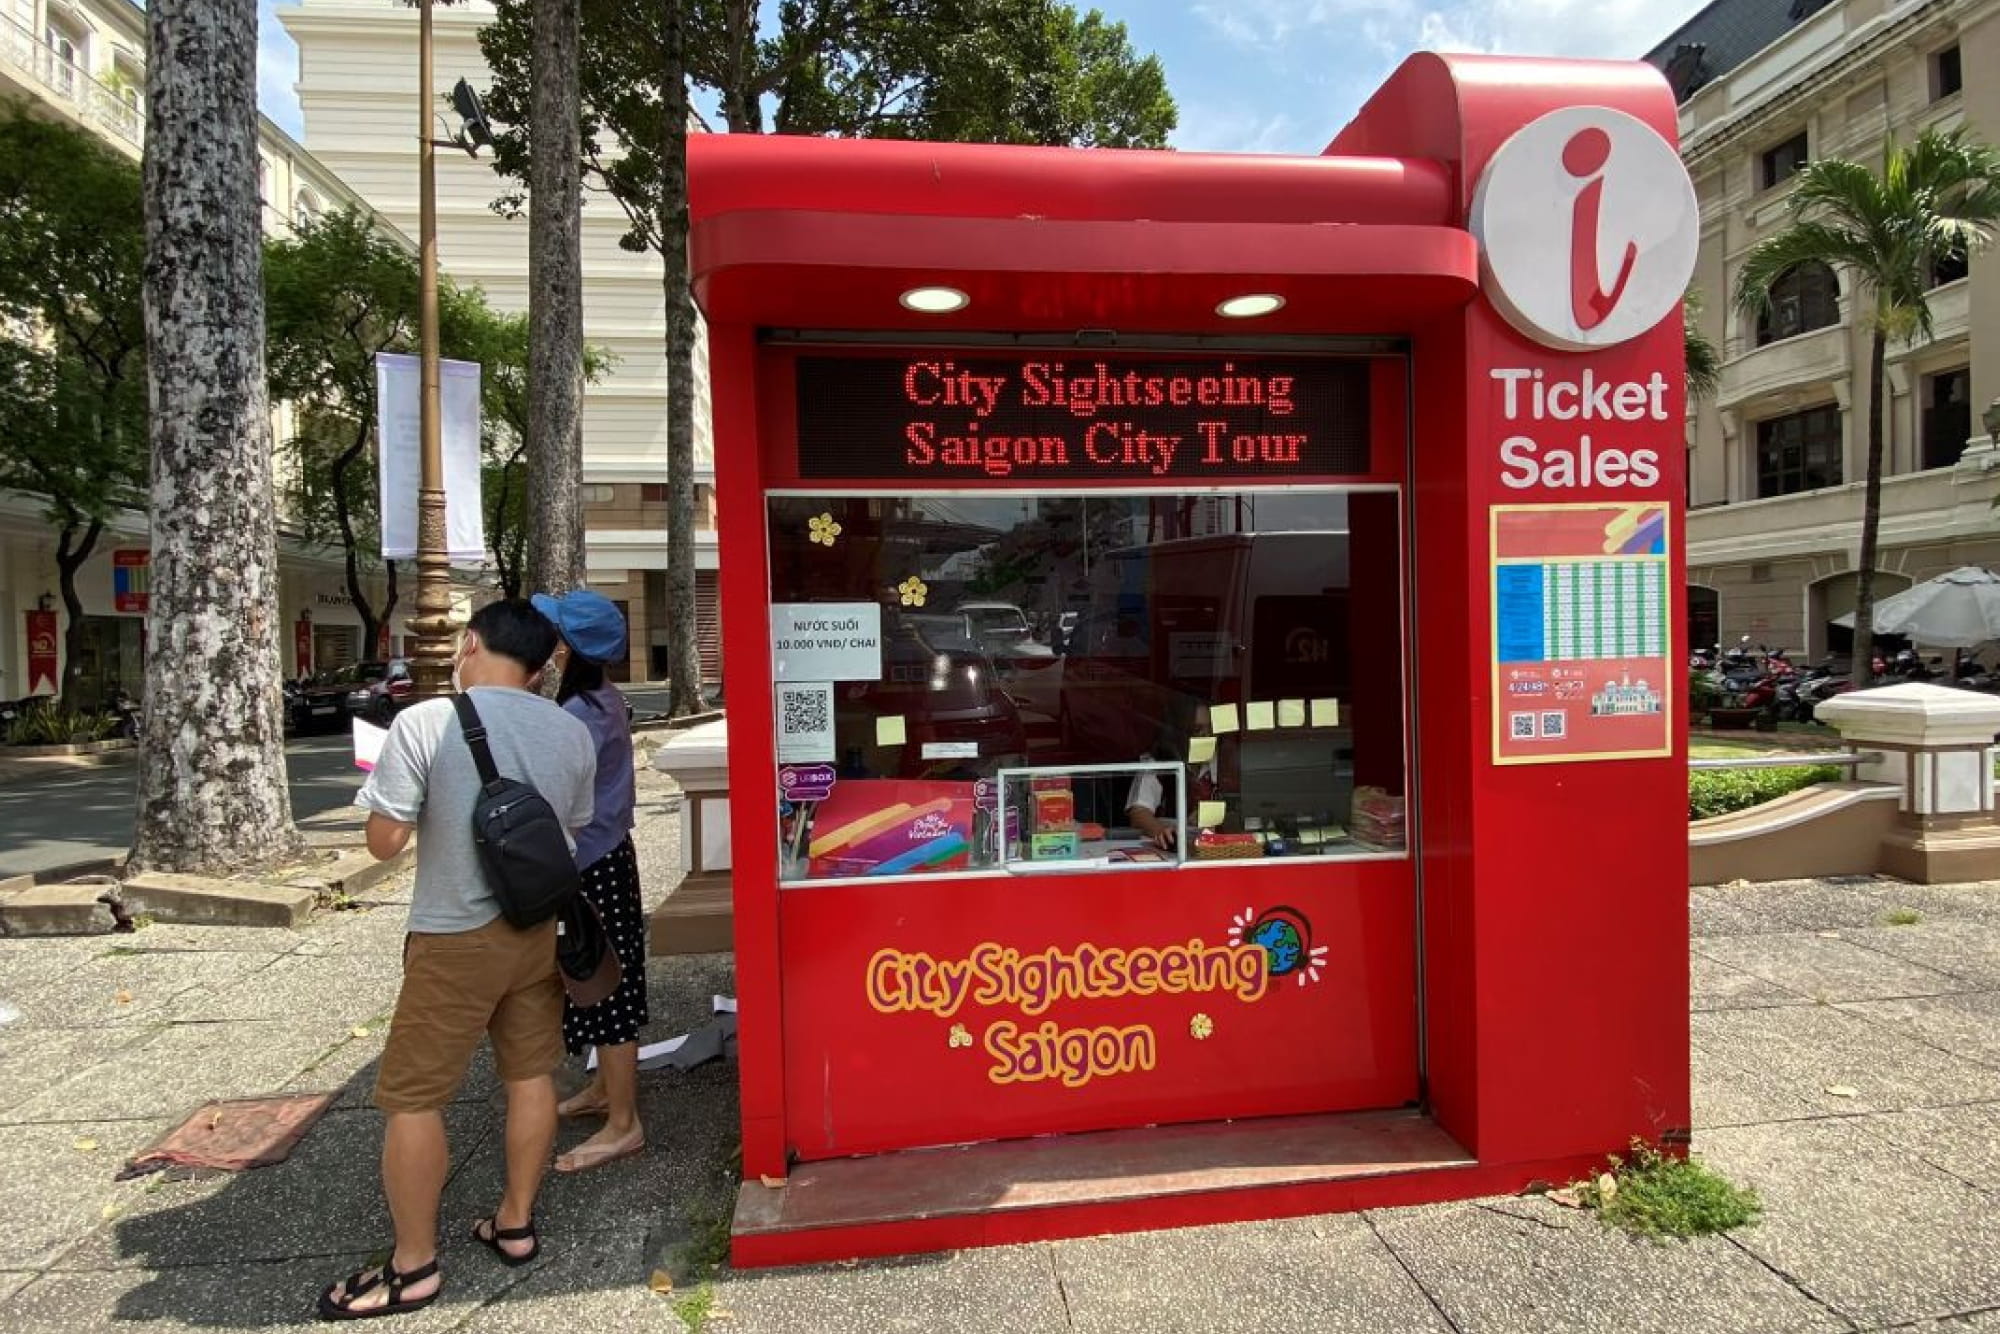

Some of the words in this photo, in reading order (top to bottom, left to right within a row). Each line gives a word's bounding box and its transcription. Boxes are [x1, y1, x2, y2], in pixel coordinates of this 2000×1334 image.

[905, 362, 1005, 417] City
[1023, 363, 1293, 416] Sightseeing
[1490, 368, 1668, 420] Ticket
[907, 422, 1068, 475] Saigon
[1085, 422, 1182, 474] City
[1198, 422, 1306, 463] Tour
[1500, 435, 1660, 488] Sales
[776, 639, 814, 650] 10.000
[849, 638, 876, 649] CHAI
[985, 1020, 1156, 1087] Saigon
